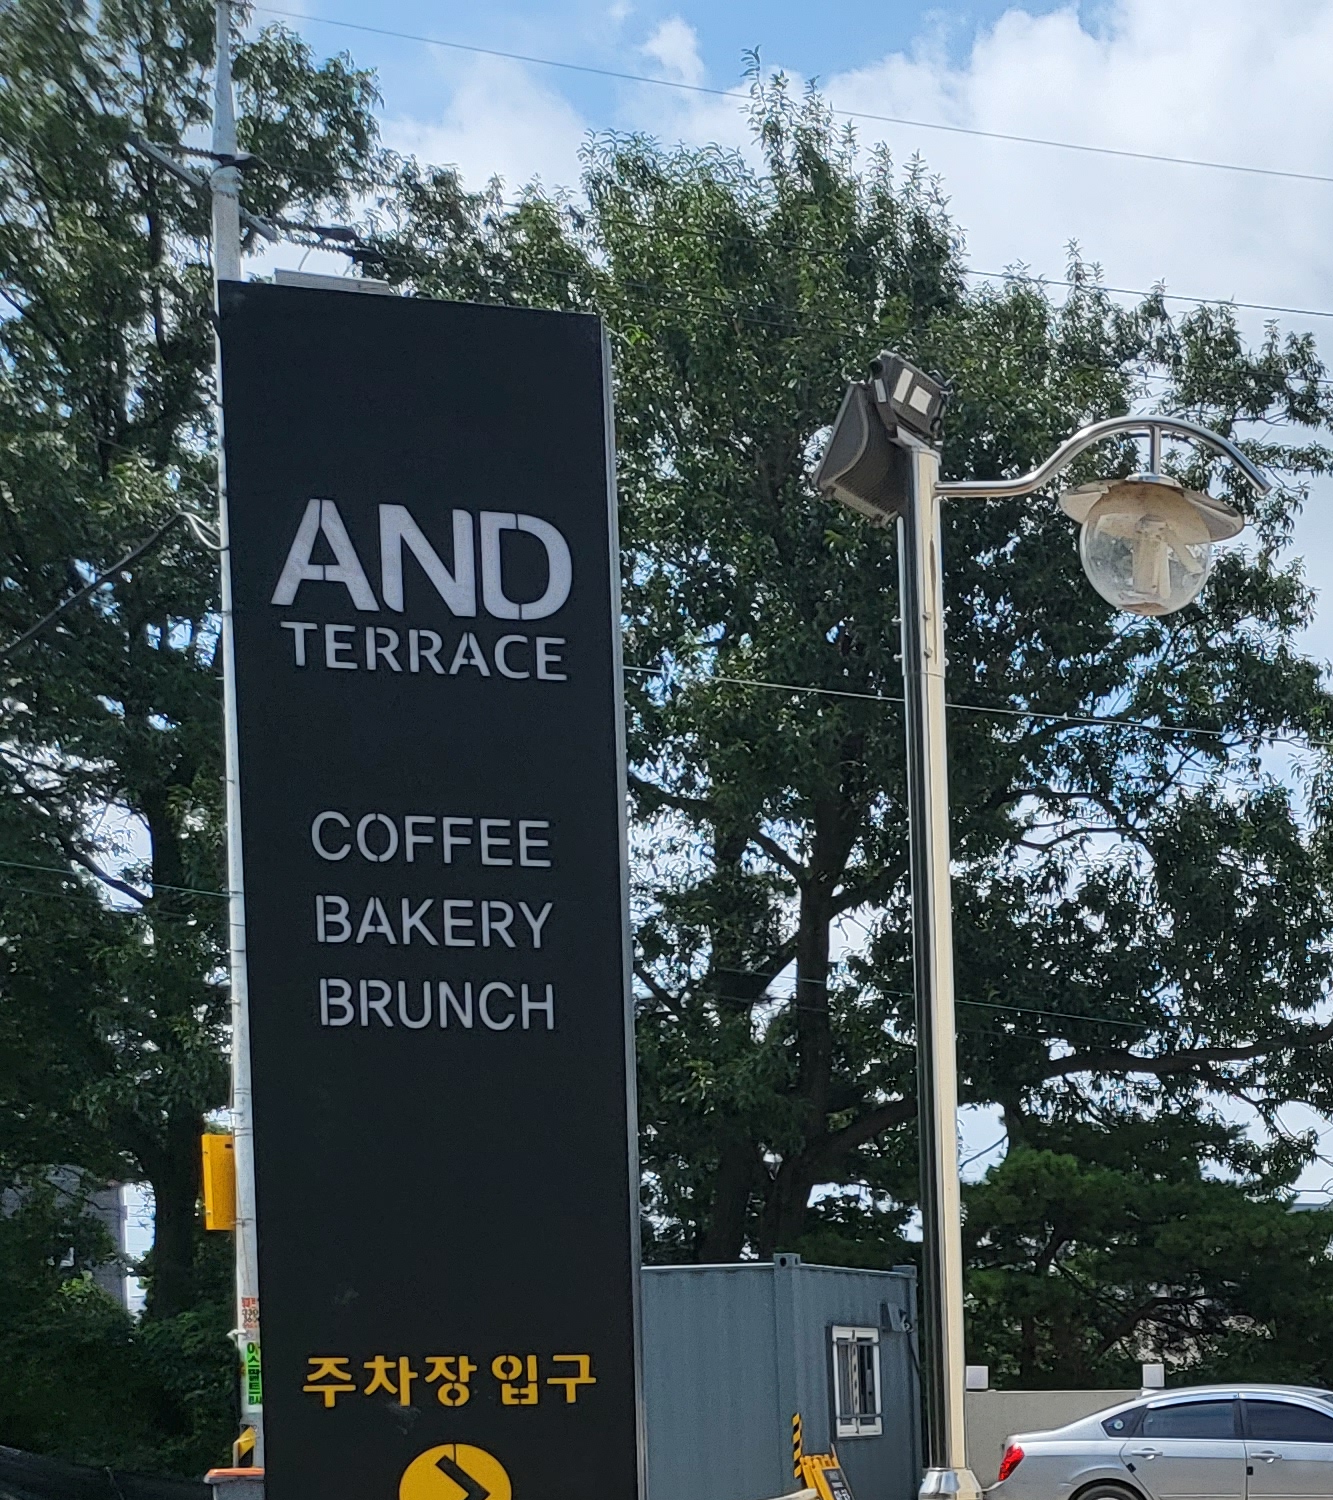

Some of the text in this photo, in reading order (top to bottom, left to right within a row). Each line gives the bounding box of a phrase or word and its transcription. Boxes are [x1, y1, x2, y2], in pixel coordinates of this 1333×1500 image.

[271, 499, 573, 621] AND
[281, 621, 568, 681] TERRACE
[311, 811, 552, 867] COFFEE
[315, 895, 554, 949] BAKERY
[319, 978, 554, 1031] BRUNCH
[302, 1354, 597, 1408] 주차장 입구
